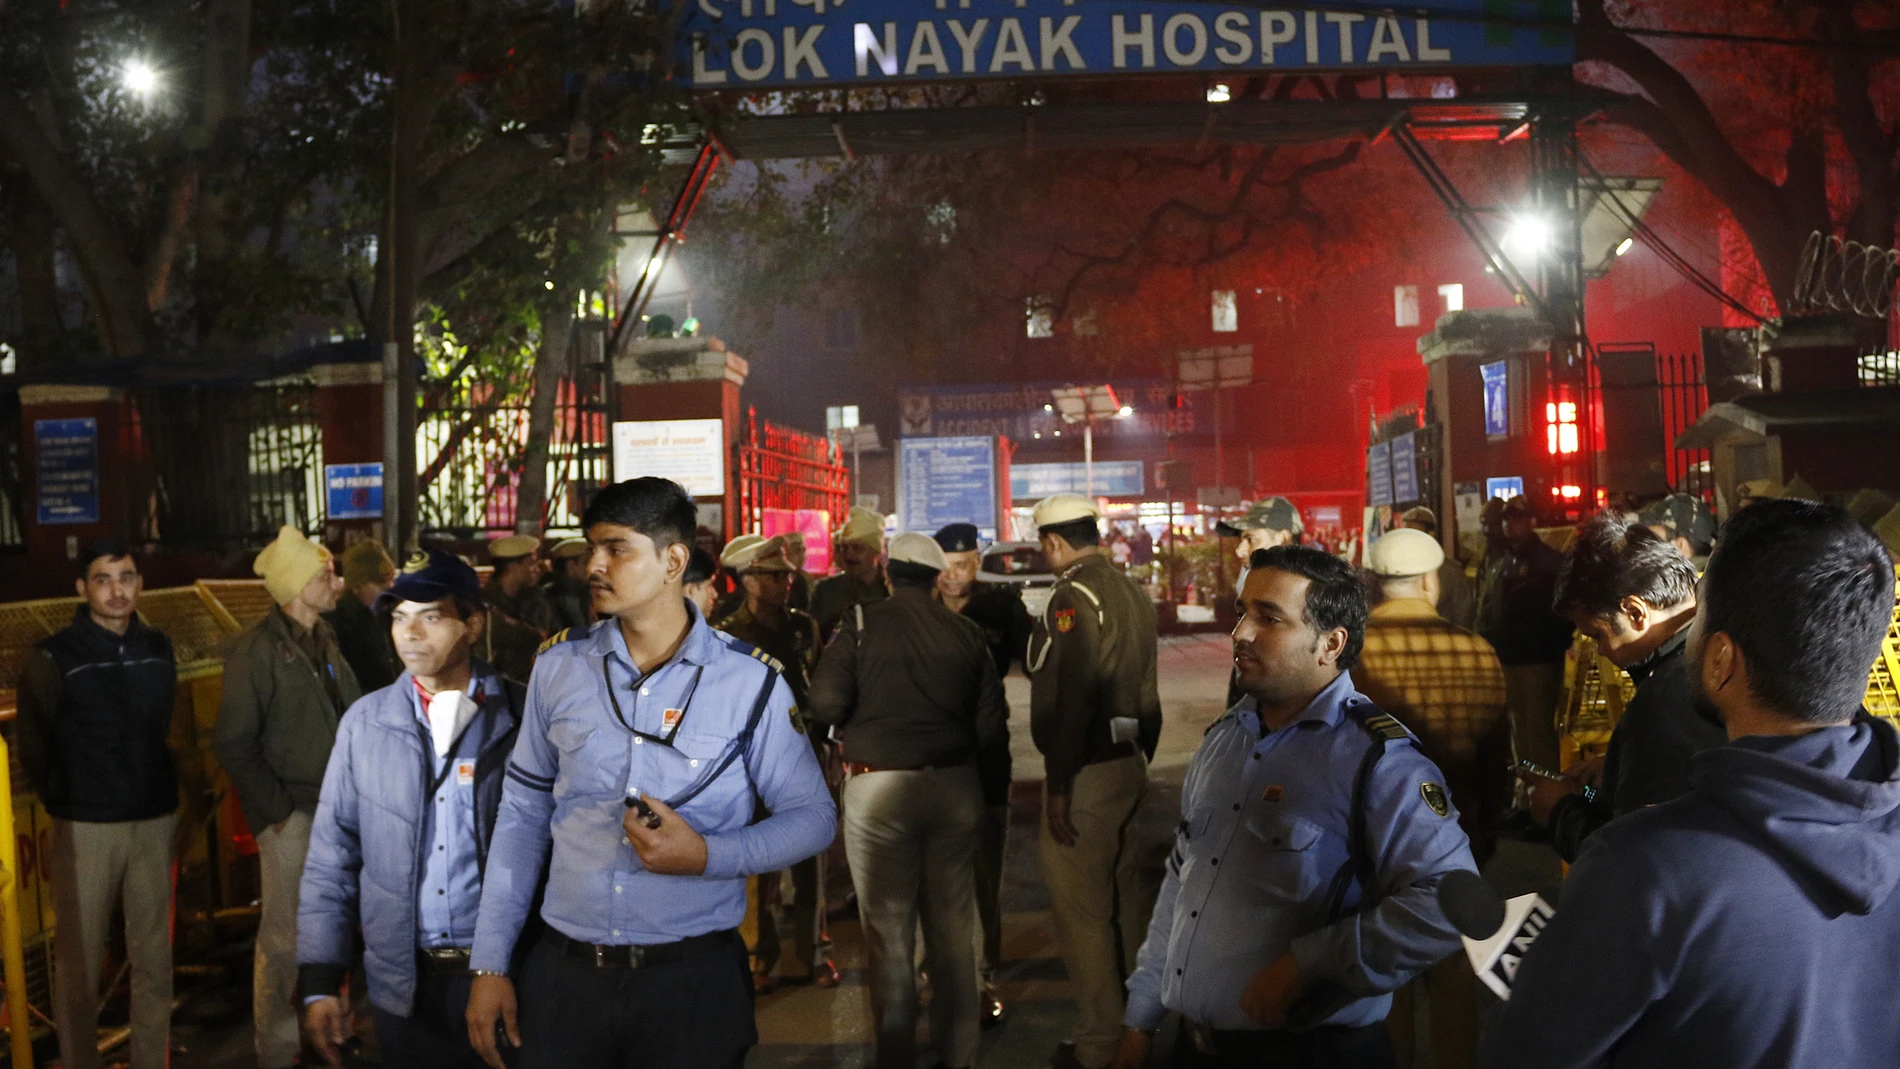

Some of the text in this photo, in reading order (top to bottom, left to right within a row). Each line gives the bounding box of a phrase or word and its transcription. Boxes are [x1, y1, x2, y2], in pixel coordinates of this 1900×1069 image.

[693, 9, 1452, 85] LOK NAYAK HOSPITAL
